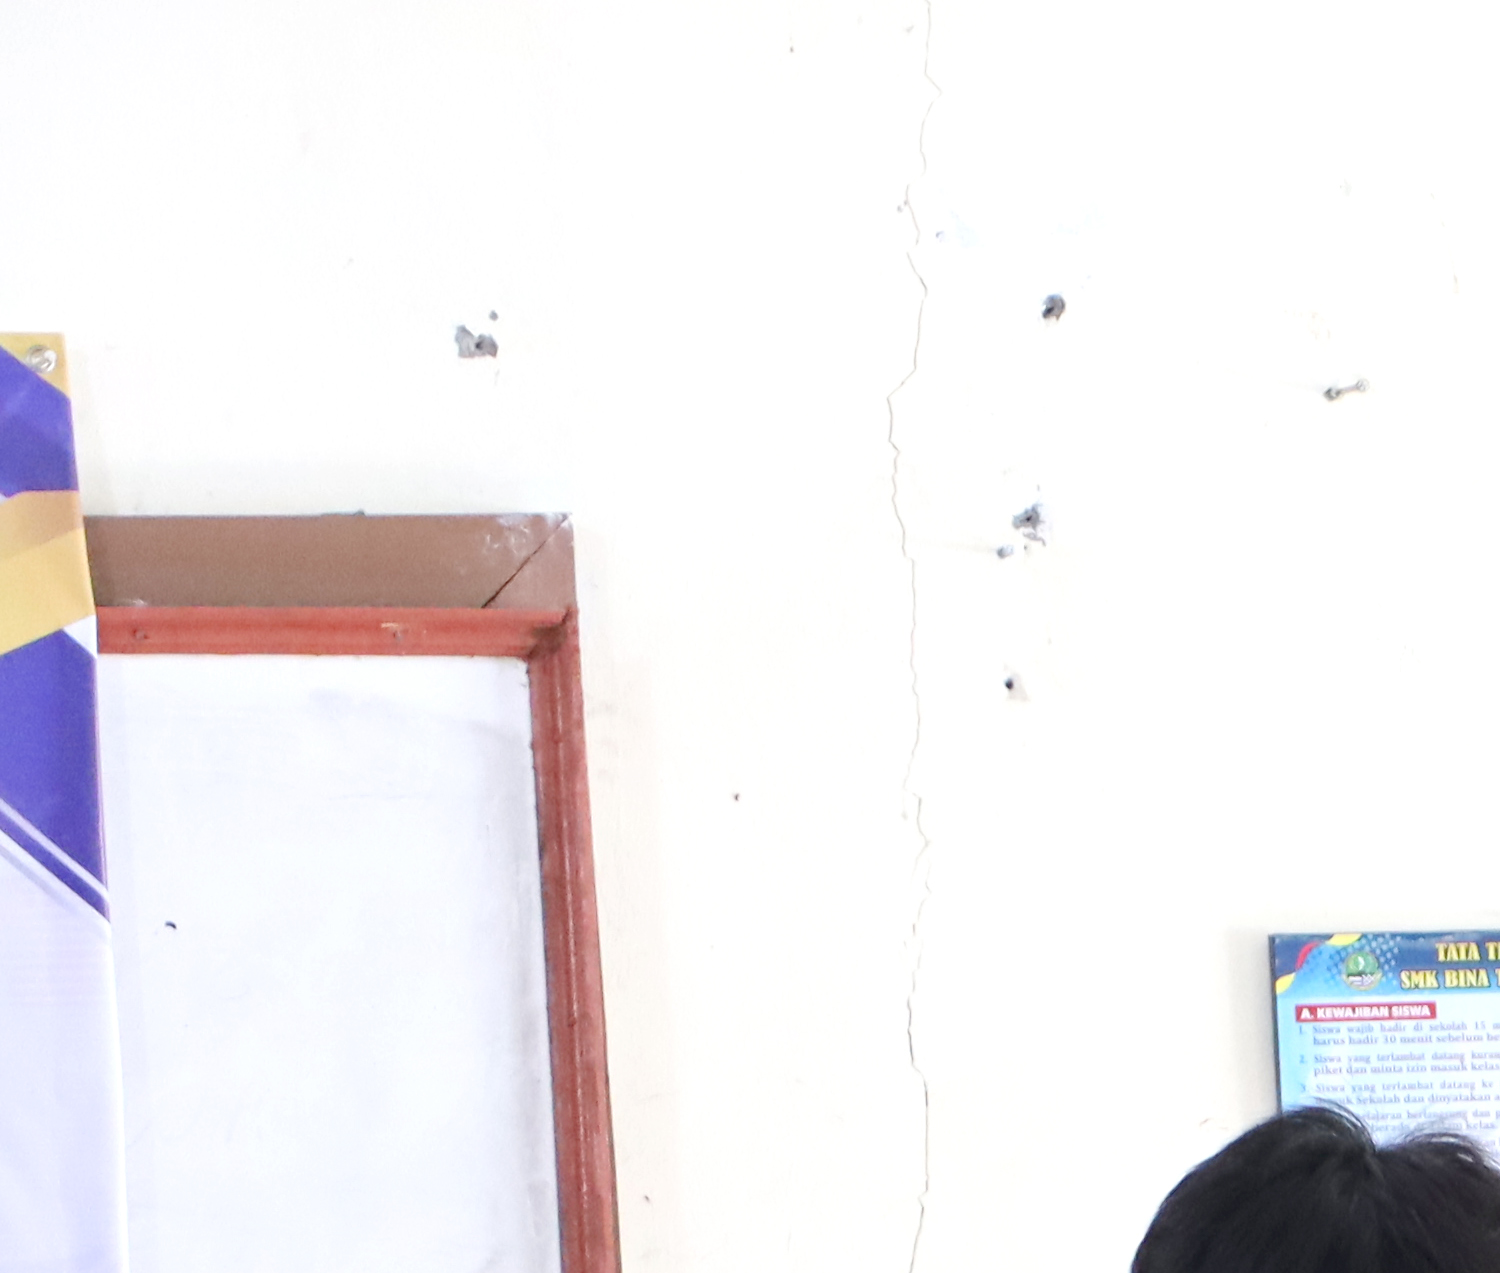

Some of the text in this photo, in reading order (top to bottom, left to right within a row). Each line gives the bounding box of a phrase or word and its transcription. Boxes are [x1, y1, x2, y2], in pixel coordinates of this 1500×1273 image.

[1435, 942, 1480, 962] TATA
[1400, 969, 1439, 989] SMK
[1444, 969, 1489, 988] BINA
[1316, 1005, 1389, 1018] KEWAJIBAN
[1391, 1004, 1431, 1017] SISWA
[1429, 1021, 1467, 1031] sekolah
[1435, 1033, 1483, 1042] sebelum
[1346, 1064, 1367, 1074] dan
[1430, 1062, 1467, 1072] masuk
[1404, 1093, 1425, 1103] dan
